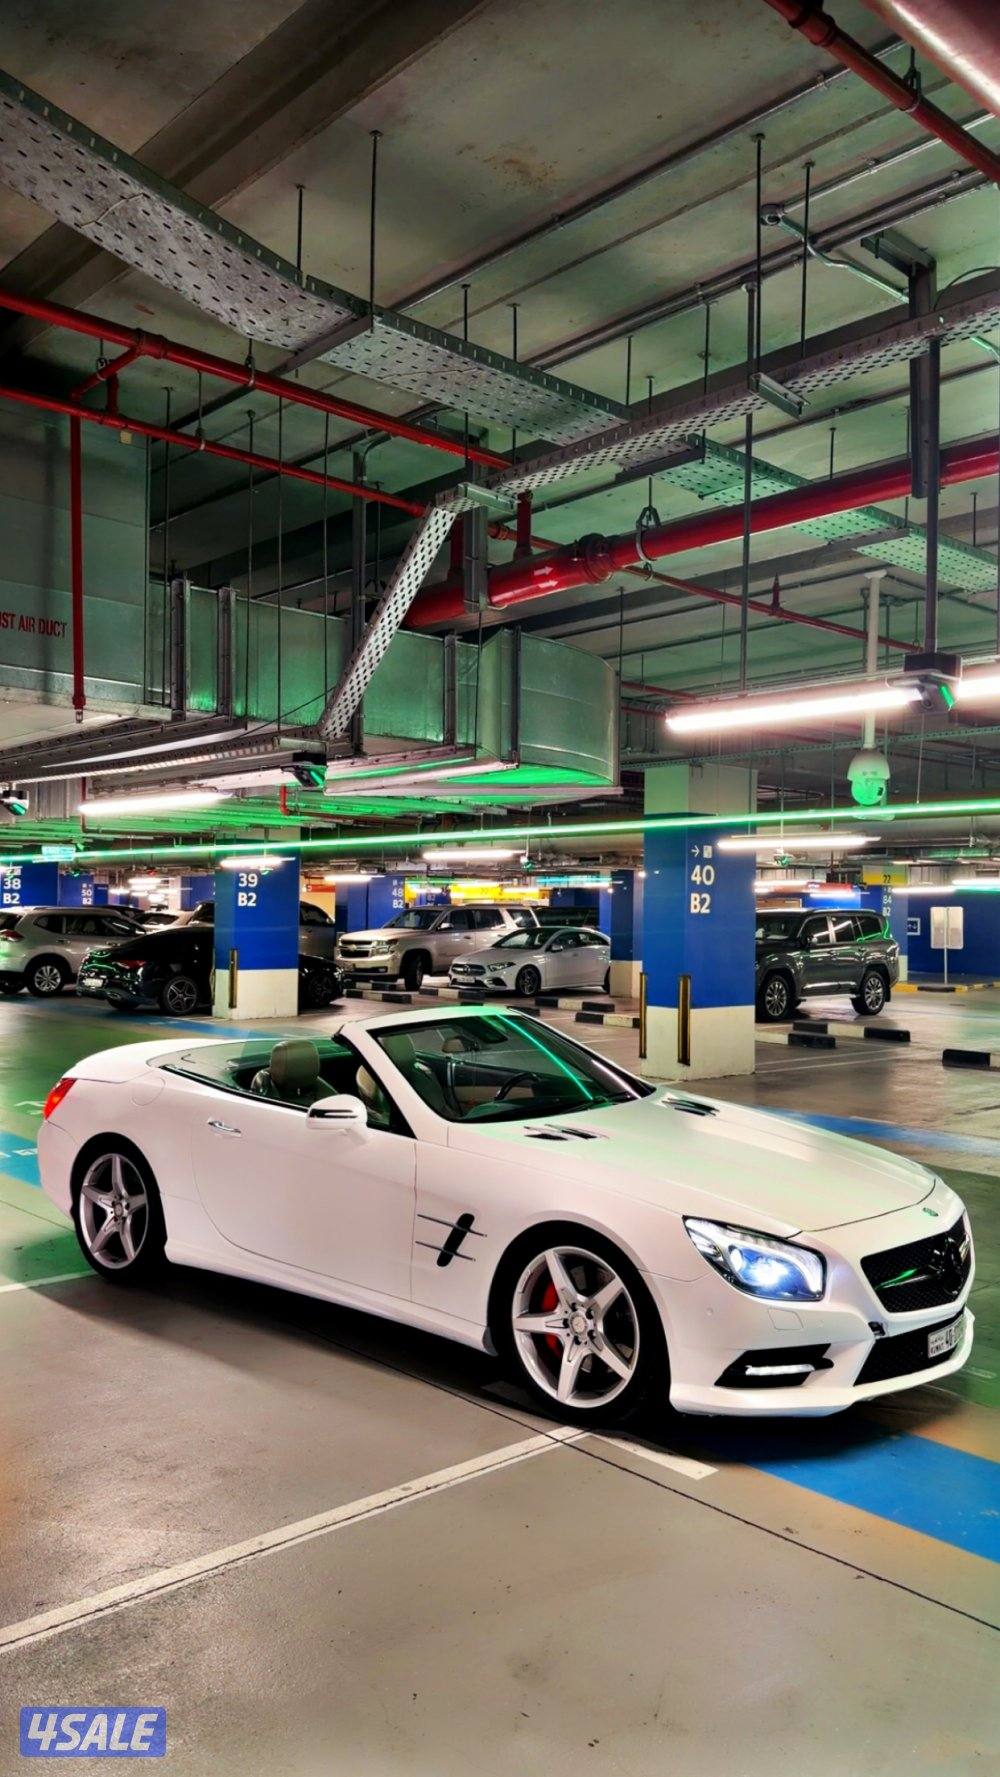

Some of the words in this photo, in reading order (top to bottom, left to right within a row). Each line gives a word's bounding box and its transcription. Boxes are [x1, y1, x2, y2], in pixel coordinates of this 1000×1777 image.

[0, 611, 16, 629] ST
[19, 614, 35, 633] AIR
[39, 618, 67, 638] DUCT
[238, 873, 258, 887] 39
[691, 865, 715, 885] 40
[3, 878, 21, 890] 38
[3, 893, 20, 904] B2
[82, 889, 92, 897] 50
[392, 888, 403, 897] 48
[238, 892, 257, 907] B2
[392, 899, 404, 908] B2
[690, 893, 711, 914] B2
